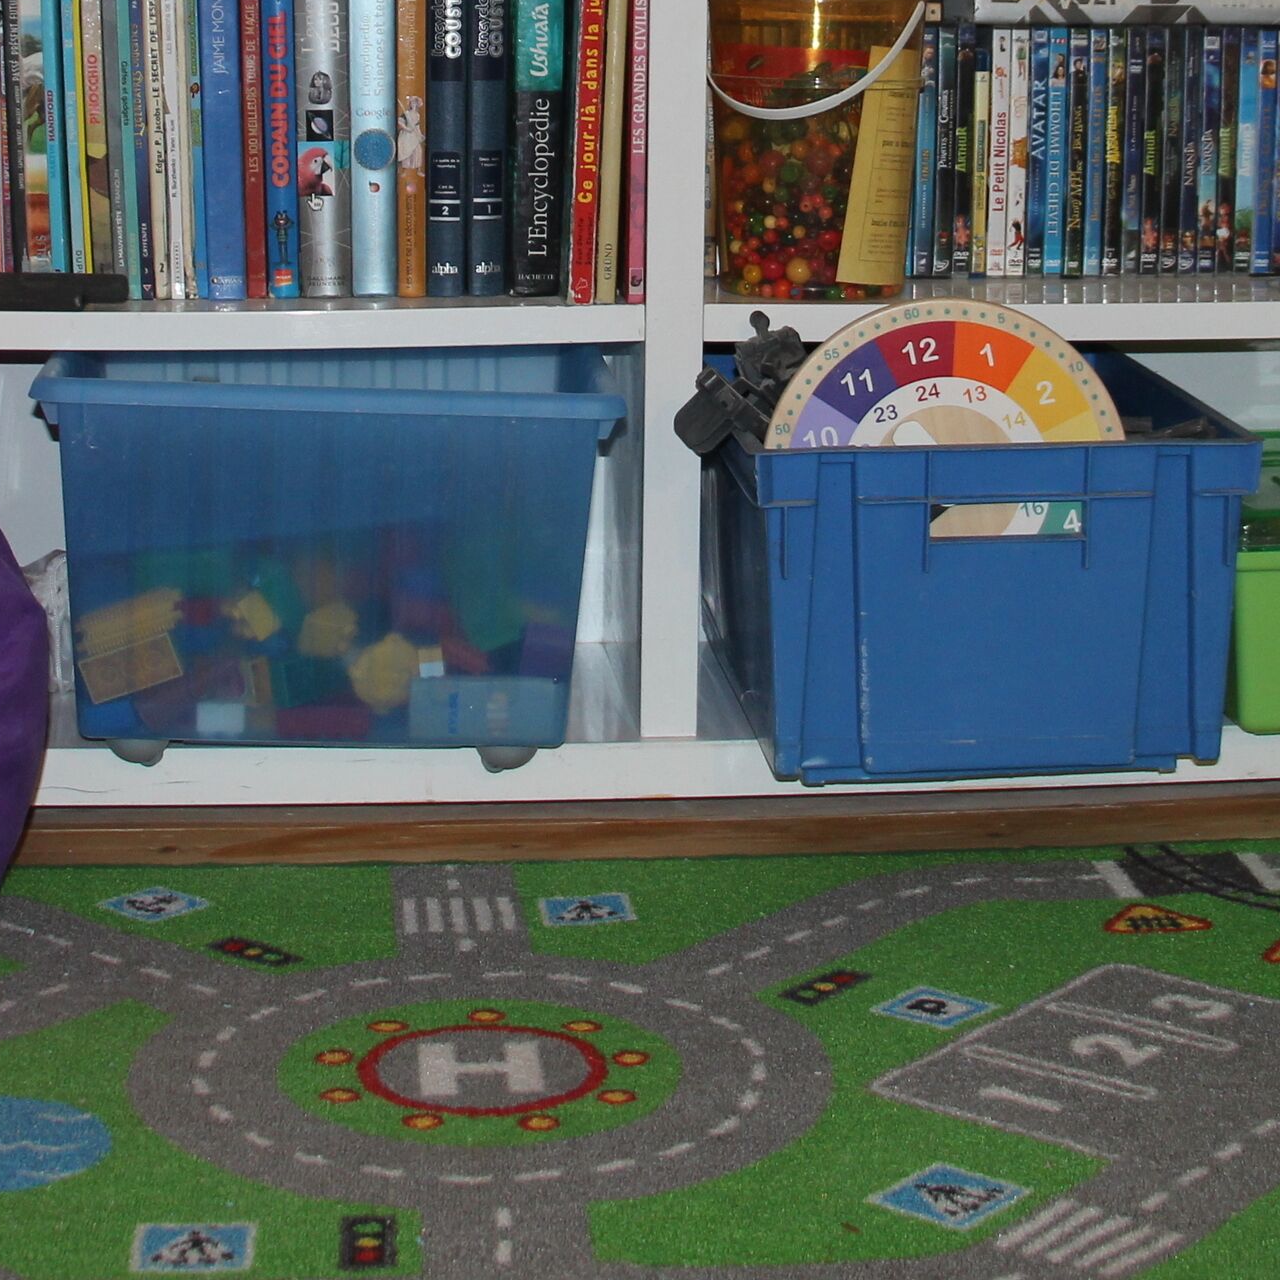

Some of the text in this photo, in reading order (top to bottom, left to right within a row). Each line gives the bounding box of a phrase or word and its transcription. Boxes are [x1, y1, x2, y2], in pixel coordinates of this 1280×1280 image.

[9, 21, 19, 54] PRÉSENT
[149, 29, 158, 43] DE
[529, 3, 550, 77] Ushuaïa
[583, 24, 599, 41] la
[11, 59, 20, 81] PASSÉ
[150, 46, 160, 84] SECRET
[212, 36, 228, 74] J'AIME
[581, 49, 599, 91] dans
[87, 54, 100, 125] PINOCCHIO
[244, 4, 258, 173] LES 100 MEILLEURS TOURS DE MAGIE
[268, 11, 290, 187] COPAIN DU CIEL
[632, 56, 646, 122] GRANDES
[46, 90, 58, 179] MARTIN HANDFORD
[578, 97, 597, 172] jour-là,
[1031, 78, 1047, 160] AVATAR
[154, 136, 162, 146] P.
[631, 125, 645, 154] LES
[956, 126, 968, 172] ARTHUR
[1144, 129, 1156, 175] ARTHUR
[1202, 129, 1214, 175] NARNIA
[1219, 127, 1231, 177] ARTHUR
[154, 150, 164, 174] Edgar
[526, 97, 551, 257] L'Encyclopédie
[991, 112, 1007, 212] Le Petit Nicolas
[1047, 90, 1062, 236] L'HOMME DE CHEVET
[1184, 141, 1195, 186] NARNIA
[577, 180, 593, 204] Ce
[113, 168, 124, 267] LA MAUVAISE TÊTE FRANQUIN
[441, 206, 450, 215] 2
[904, 307, 920, 320] 60
[997, 313, 1005, 324] 5
[824, 348, 839, 360] 55
[901, 336, 940, 366] 12
[979, 343, 996, 367] 1
[839, 368, 875, 396] 11
[1069, 361, 1084, 373] 10
[915, 382, 940, 401] 24
[963, 385, 987, 404] 13
[1036, 380, 1056, 405] 2
[775, 423, 791, 435] 50
[874, 404, 899, 423] 23
[1002, 411, 1026, 430] 14
[1063, 509, 1082, 534] 4
[1152, 992, 1234, 1022] 3
[1071, 1033, 1164, 1068] 2
[417, 1040, 546, 1098] H
